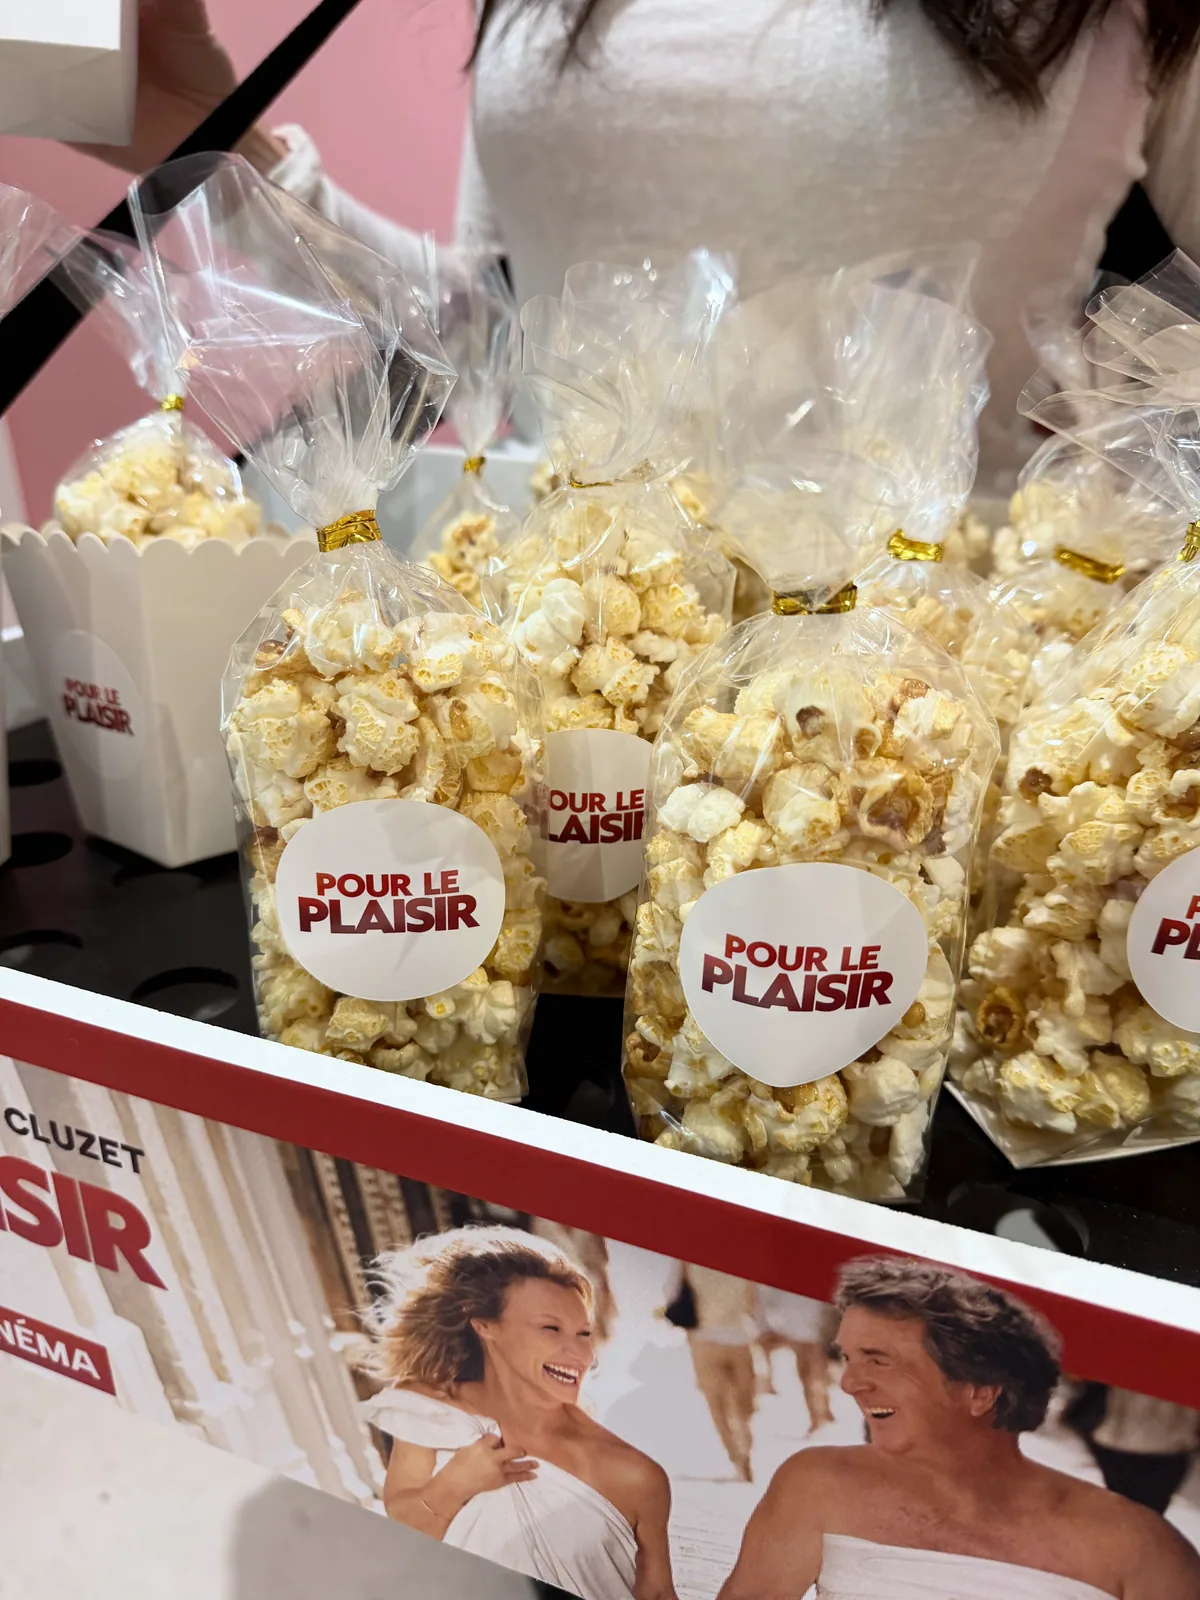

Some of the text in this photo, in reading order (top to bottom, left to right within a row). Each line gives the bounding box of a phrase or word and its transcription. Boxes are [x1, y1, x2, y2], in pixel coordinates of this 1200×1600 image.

[64, 677, 121, 706] POUR LE
[63, 692, 135, 736] PLAISIR
[616, 789, 645, 811] LE
[316, 870, 460, 897] POUR LE
[298, 894, 480, 934] PLAISIR
[724, 933, 881, 971] POUR LE
[701, 953, 893, 1012] PLAISIR
[4, 1107, 145, 1174] CLUZET
